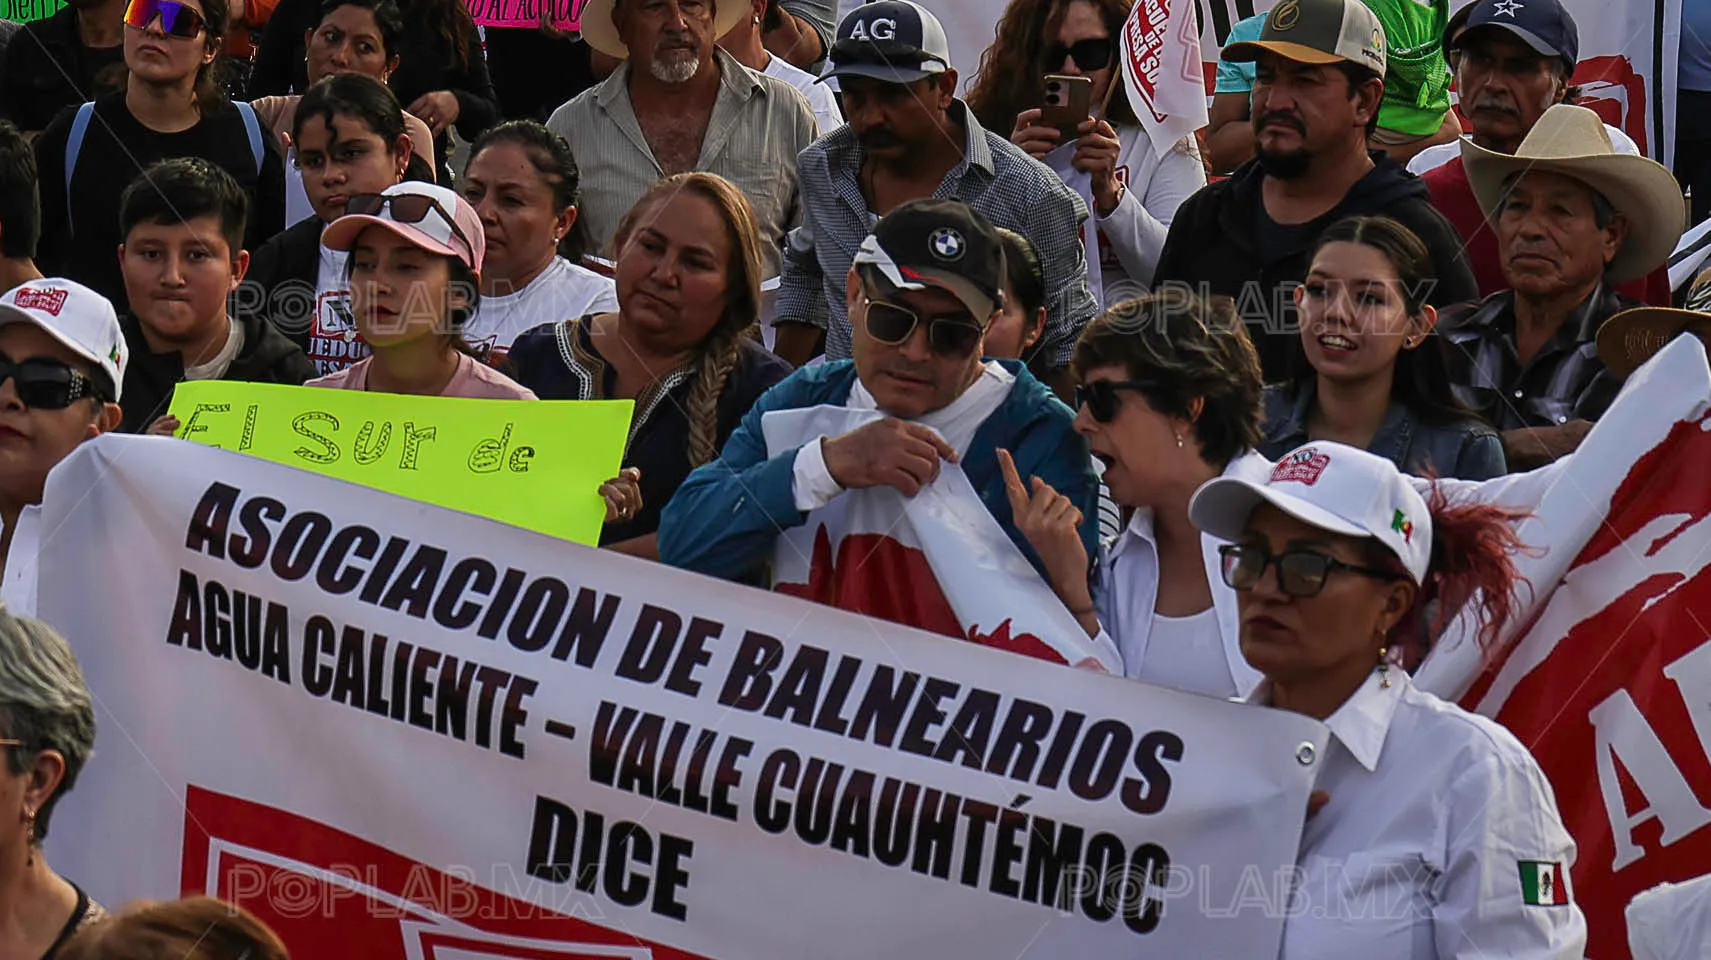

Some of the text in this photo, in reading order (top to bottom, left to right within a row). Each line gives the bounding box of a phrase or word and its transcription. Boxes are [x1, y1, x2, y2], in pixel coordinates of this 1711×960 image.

[467, 422, 535, 474] de
[166, 569, 1171, 934] AGUA CALIENTE VALLE CUAUHTÉMOC
[186, 481, 1185, 816] ASOCIACION DE BALNEARIOS
[526, 794, 694, 922] DICE
